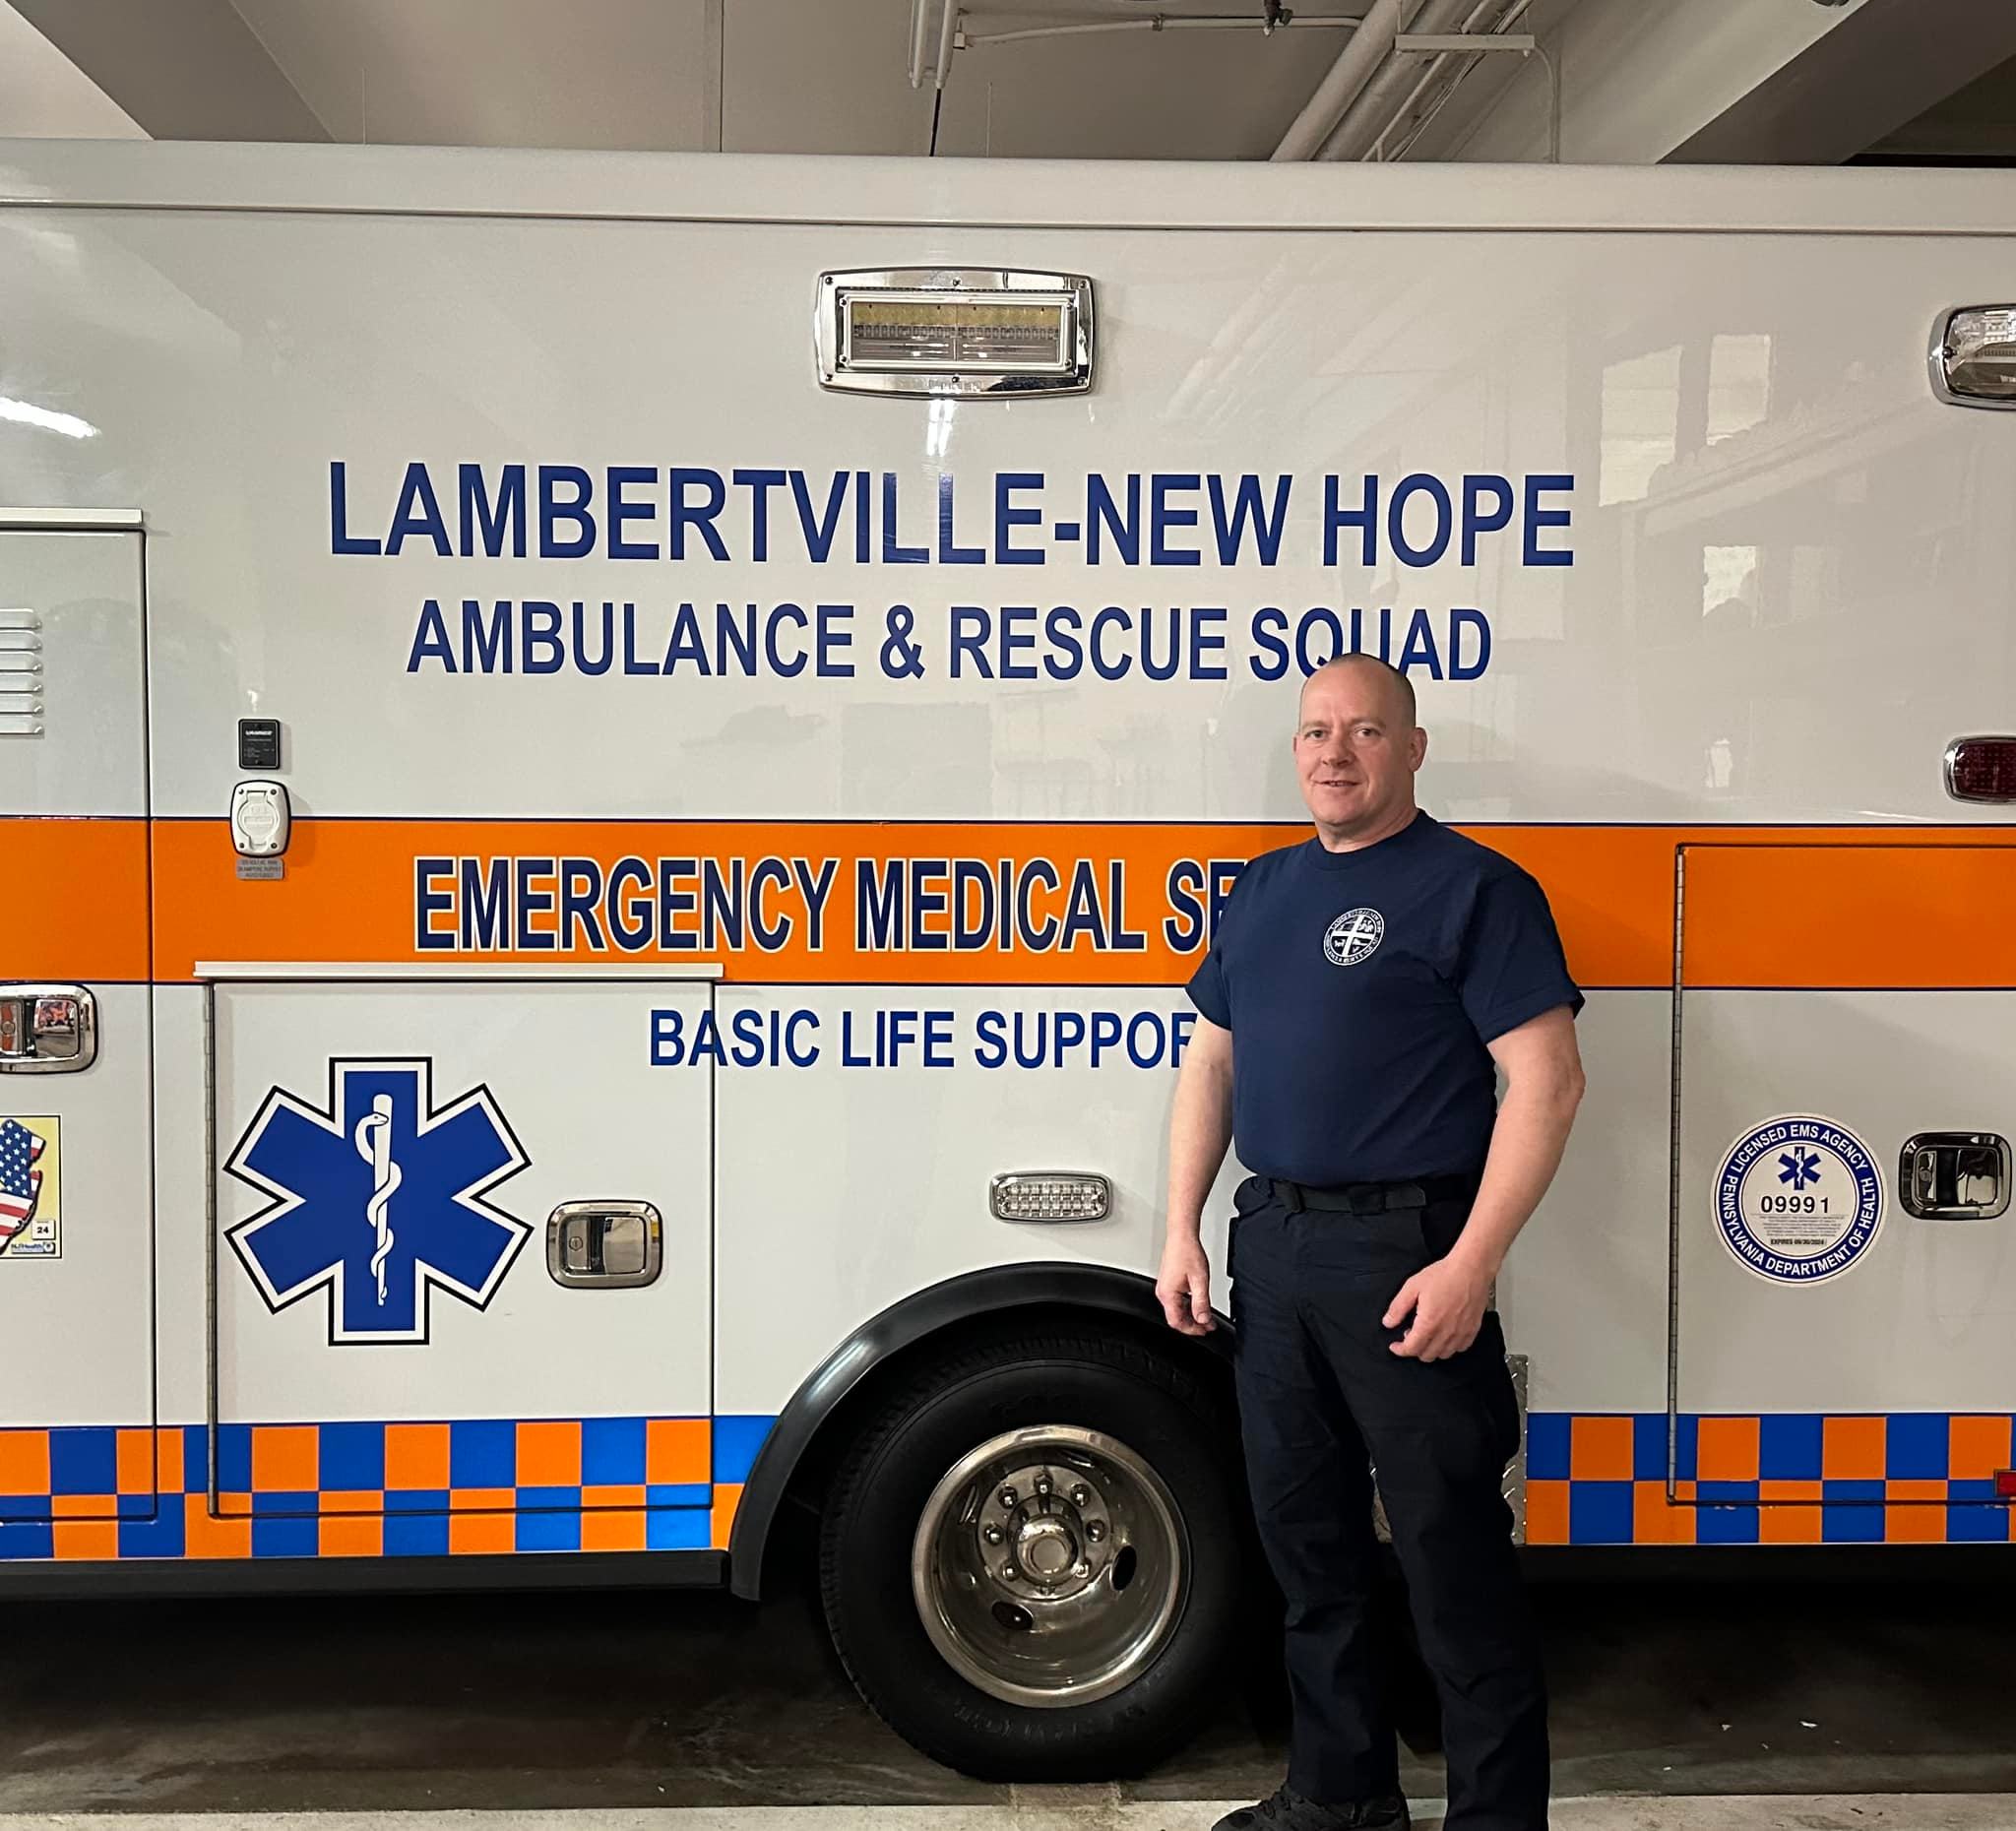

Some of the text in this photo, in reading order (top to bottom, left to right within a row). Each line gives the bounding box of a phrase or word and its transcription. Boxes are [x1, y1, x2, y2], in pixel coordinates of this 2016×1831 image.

[330, 462, 1575, 568] LAMBERTVILLE-NEW HOPE
[407, 599, 1492, 681] AMBULANCE & RESCUE SQUAD
[413, 855, 839, 953] EMERGENCY
[855, 857, 1147, 953] MEDICAL
[650, 1008, 1198, 1069] BASIC LIFE SUPPOR
[1731, 1124, 1868, 1172] LICENSED EMS AGENCY
[1723, 1174, 1764, 1265] PENNSYLVANIA
[1765, 1245, 1852, 1276] DEPARTMENT
[1849, 1229, 1864, 1248] OF
[1858, 1176, 1875, 1230] HEALTH
[1761, 1195, 1829, 1214] 09991
